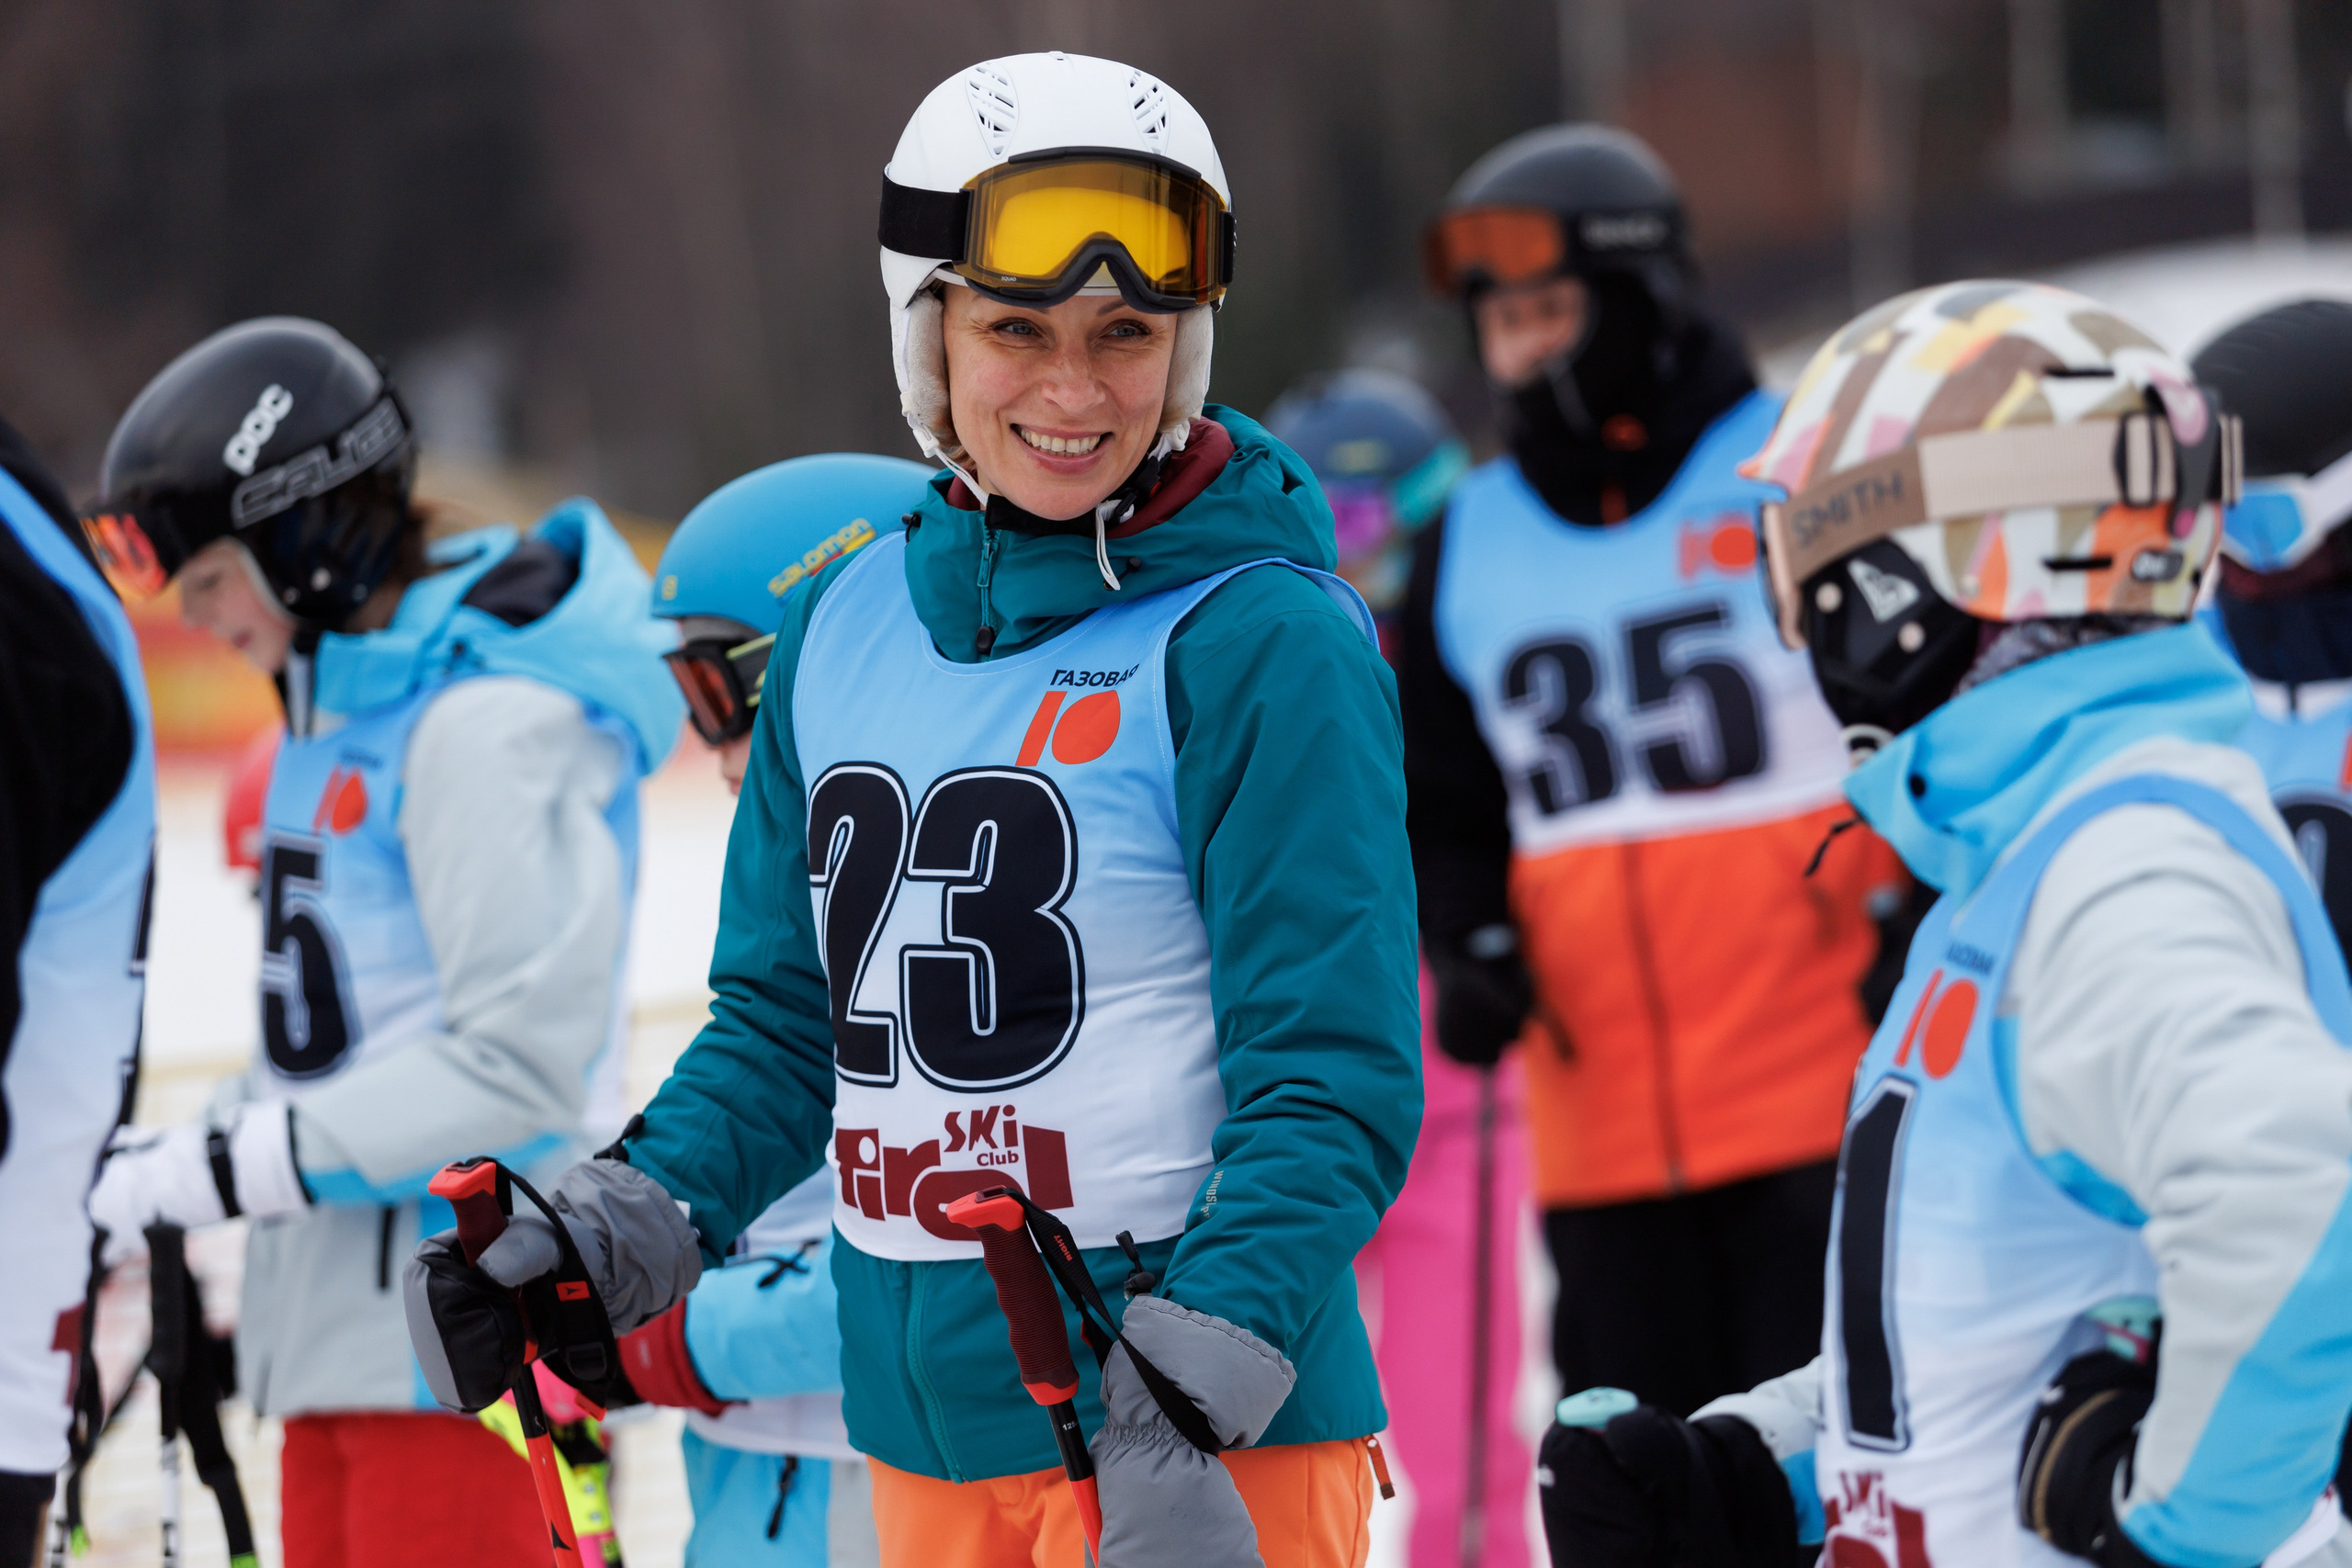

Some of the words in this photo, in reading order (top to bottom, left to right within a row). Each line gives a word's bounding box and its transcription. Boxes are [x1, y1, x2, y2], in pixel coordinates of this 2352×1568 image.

[1792, 468, 1904, 547] SMITH
[1050, 662, 1140, 687] ГАЗОВАЯ
[1498, 599, 1770, 817] 35
[807, 761, 1086, 1094] 23
[977, 1149, 1020, 1168] Club
[1054, 1235, 1073, 1261] RIGHT
